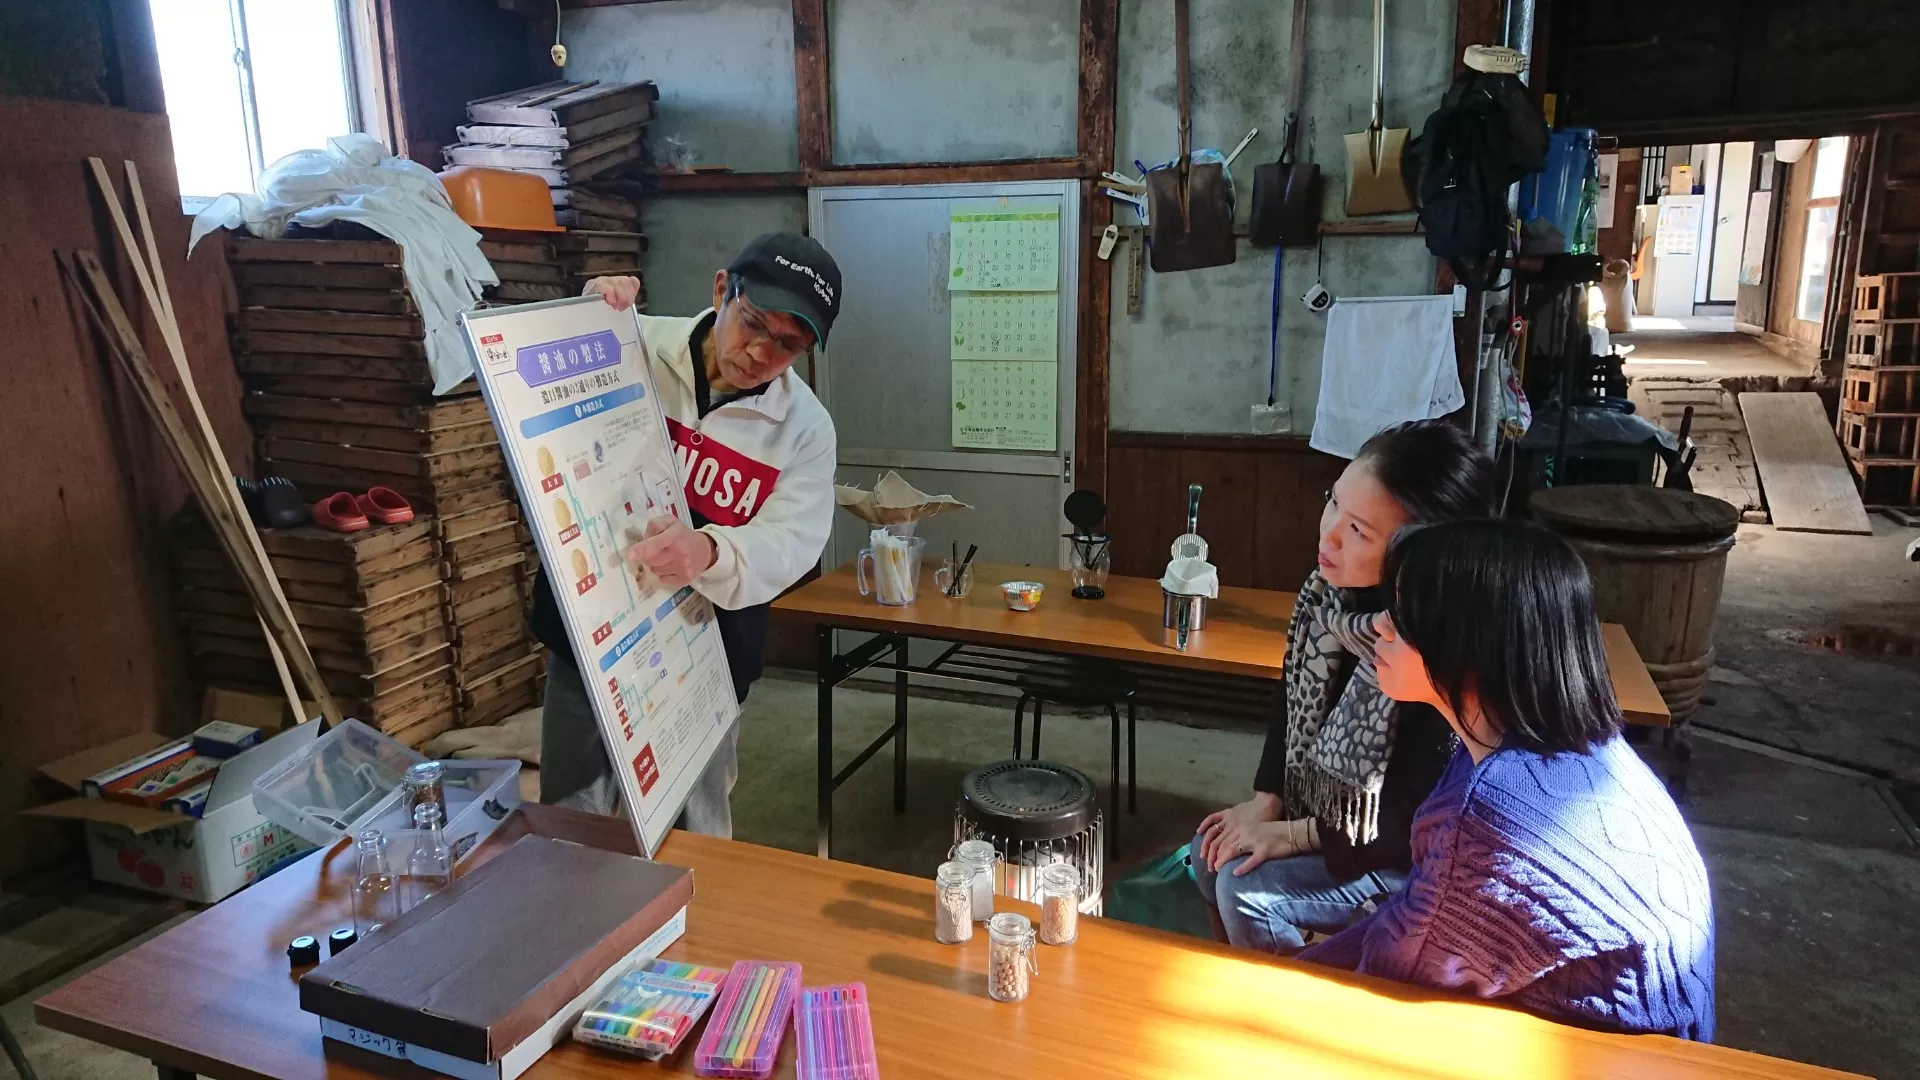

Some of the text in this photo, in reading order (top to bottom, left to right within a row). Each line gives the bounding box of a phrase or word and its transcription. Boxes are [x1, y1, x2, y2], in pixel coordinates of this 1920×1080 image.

[775, 256, 790, 266] For
[816, 273, 826, 286] For
[672, 440, 761, 517] NOSA
[264, 832, 274, 847] M
